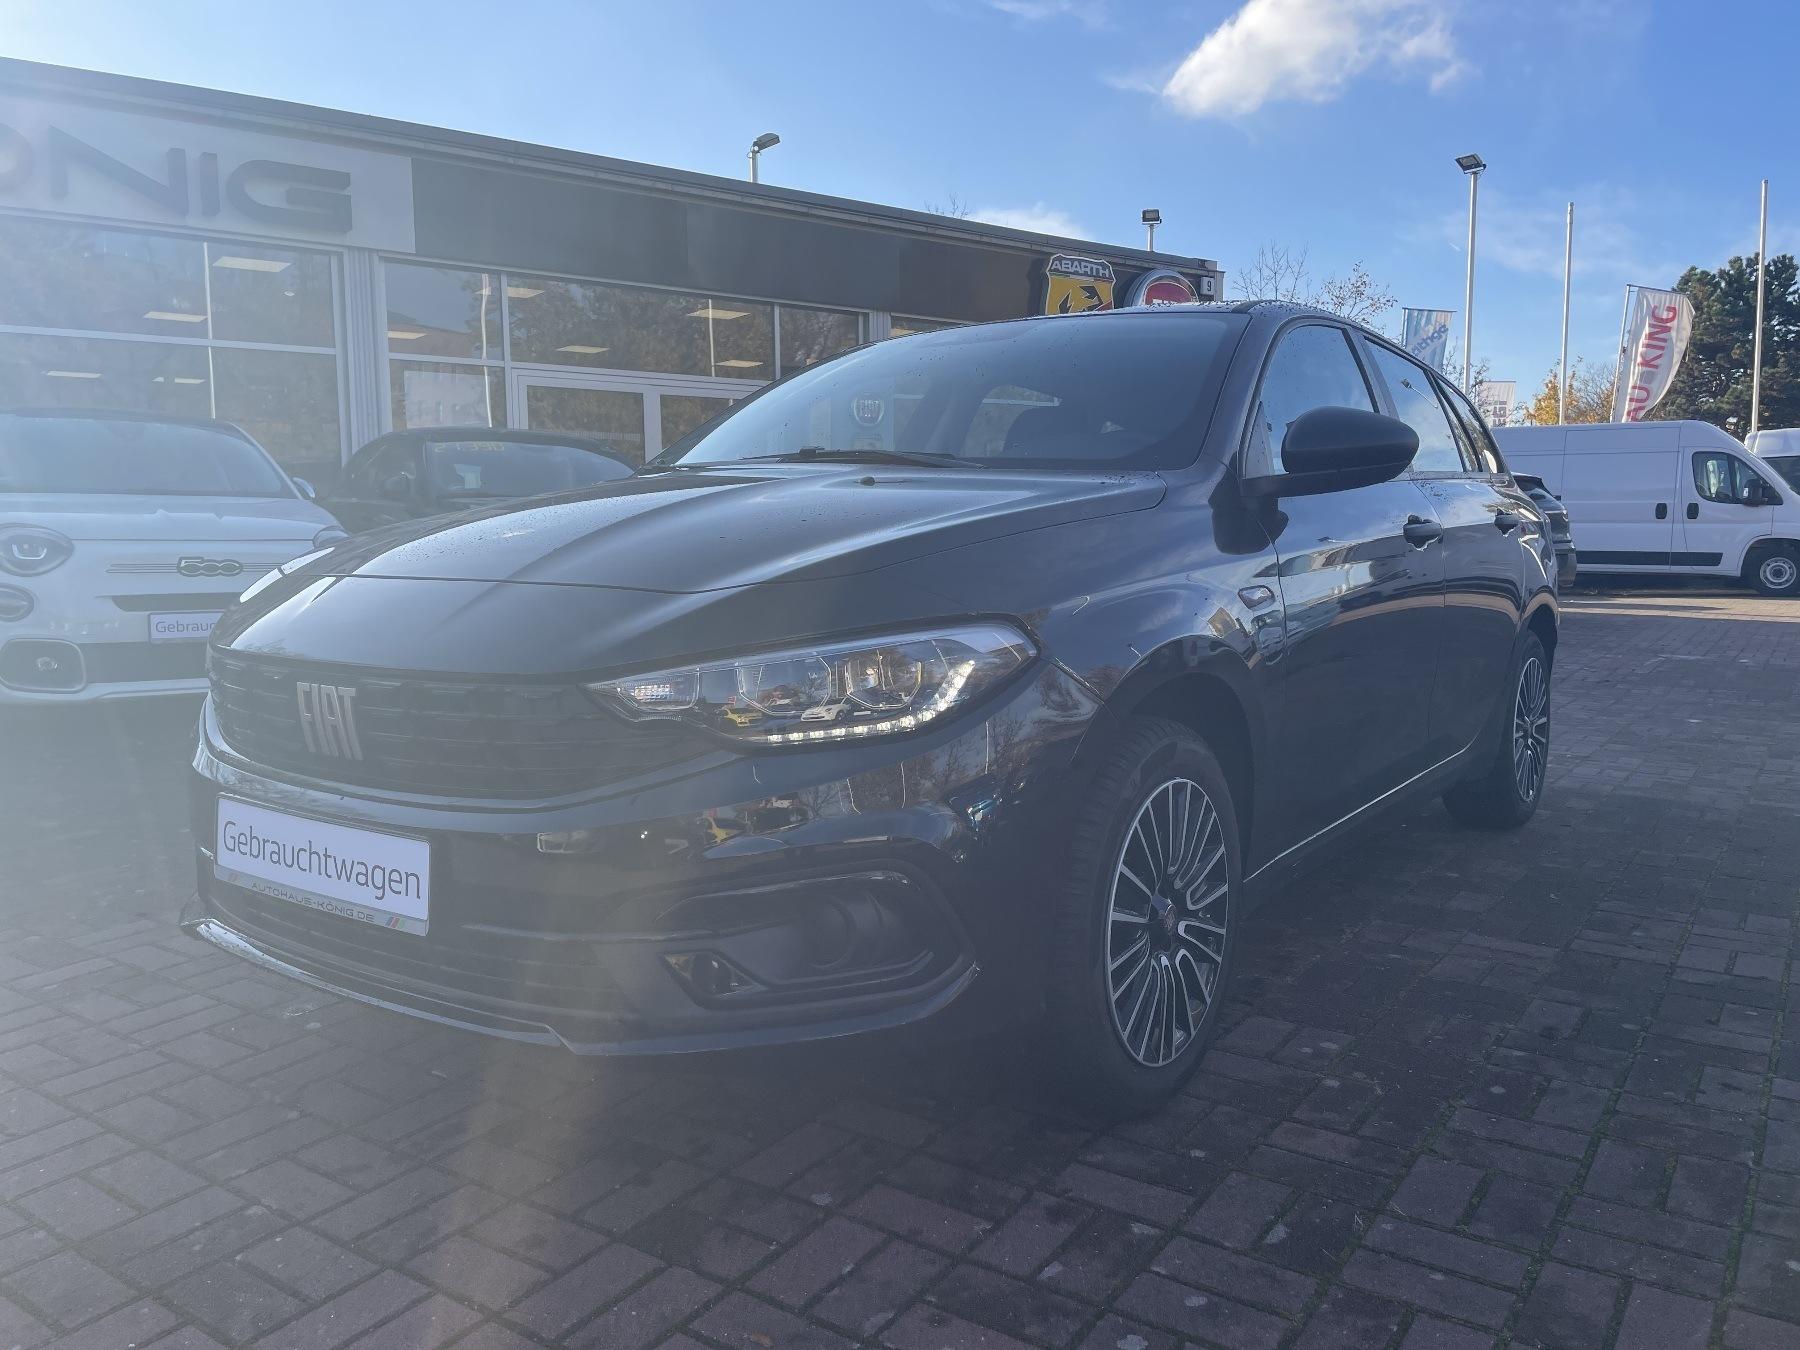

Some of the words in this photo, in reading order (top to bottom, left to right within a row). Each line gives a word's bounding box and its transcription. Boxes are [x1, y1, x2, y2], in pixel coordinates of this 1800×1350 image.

[0, 122, 353, 233] NIG
[1051, 259, 1109, 278] ABARTH
[1637, 305, 1677, 369] KING
[178, 557, 242, 577] 500
[296, 681, 364, 761] FIAT
[223, 820, 421, 901] Gebrauchtwagen
